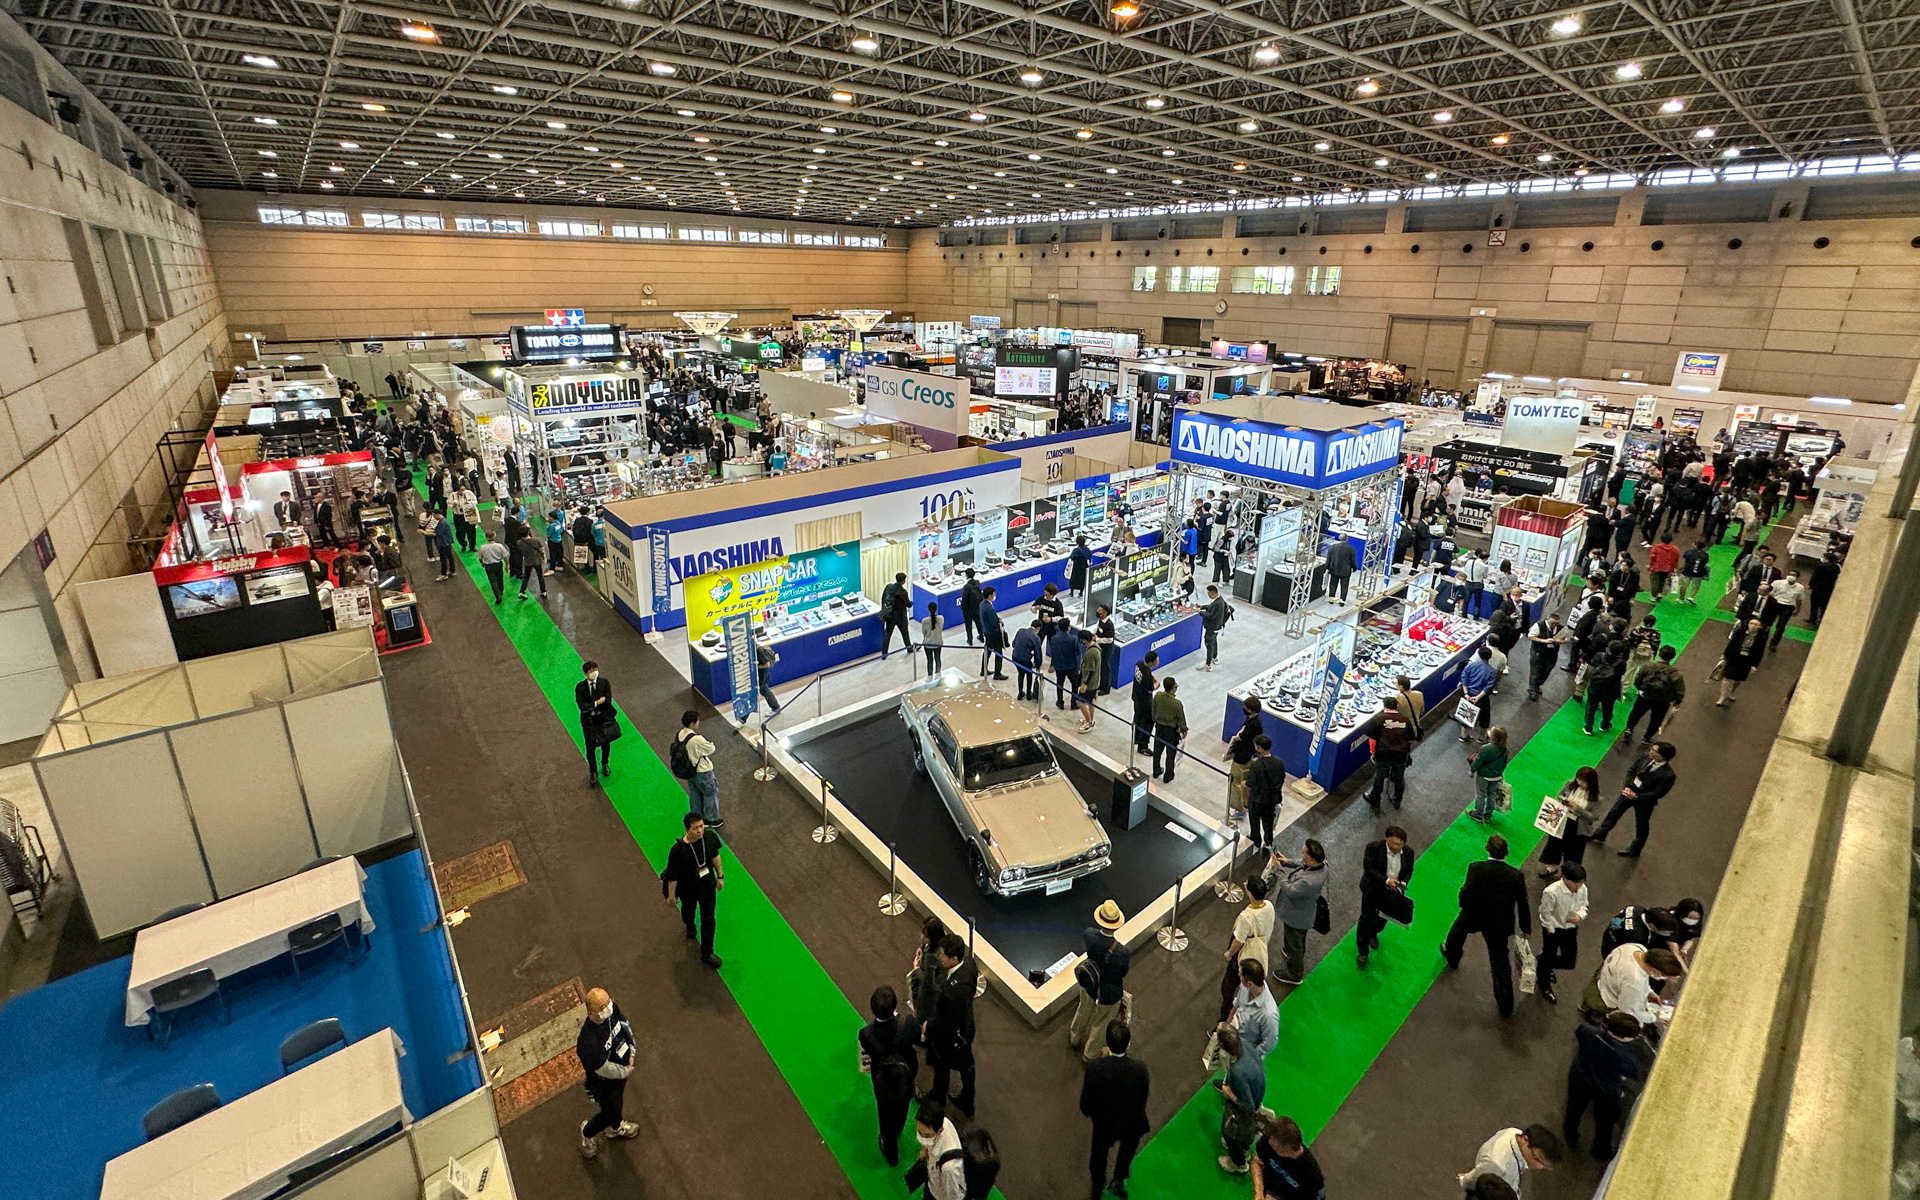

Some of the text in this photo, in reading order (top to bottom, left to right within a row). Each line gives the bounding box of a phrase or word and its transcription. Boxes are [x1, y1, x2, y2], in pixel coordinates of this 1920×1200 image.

[526, 336, 560, 348] TOKYO
[1076, 337, 1093, 345] BANDAI
[760, 347, 781, 358] KATO
[550, 378, 641, 407] DOYUSHA
[882, 378, 955, 408] GSI Creos
[537, 408, 561, 416] Leading
[1513, 404, 1579, 419] TOMYTEC
[1204, 425, 1315, 477] AOSHIMA
[1342, 426, 1400, 472] AOSHIMA
[1047, 462, 1062, 480] 10
[213, 557, 258, 572] Hobby
[681, 537, 784, 581] AOSHIMA
[654, 546, 668, 597] AOSHIMA
[706, 600, 753, 617] カーモデルに
[756, 586, 812, 605] チャレンジしたい
[1048, 882, 1071, 891] NISSAN
